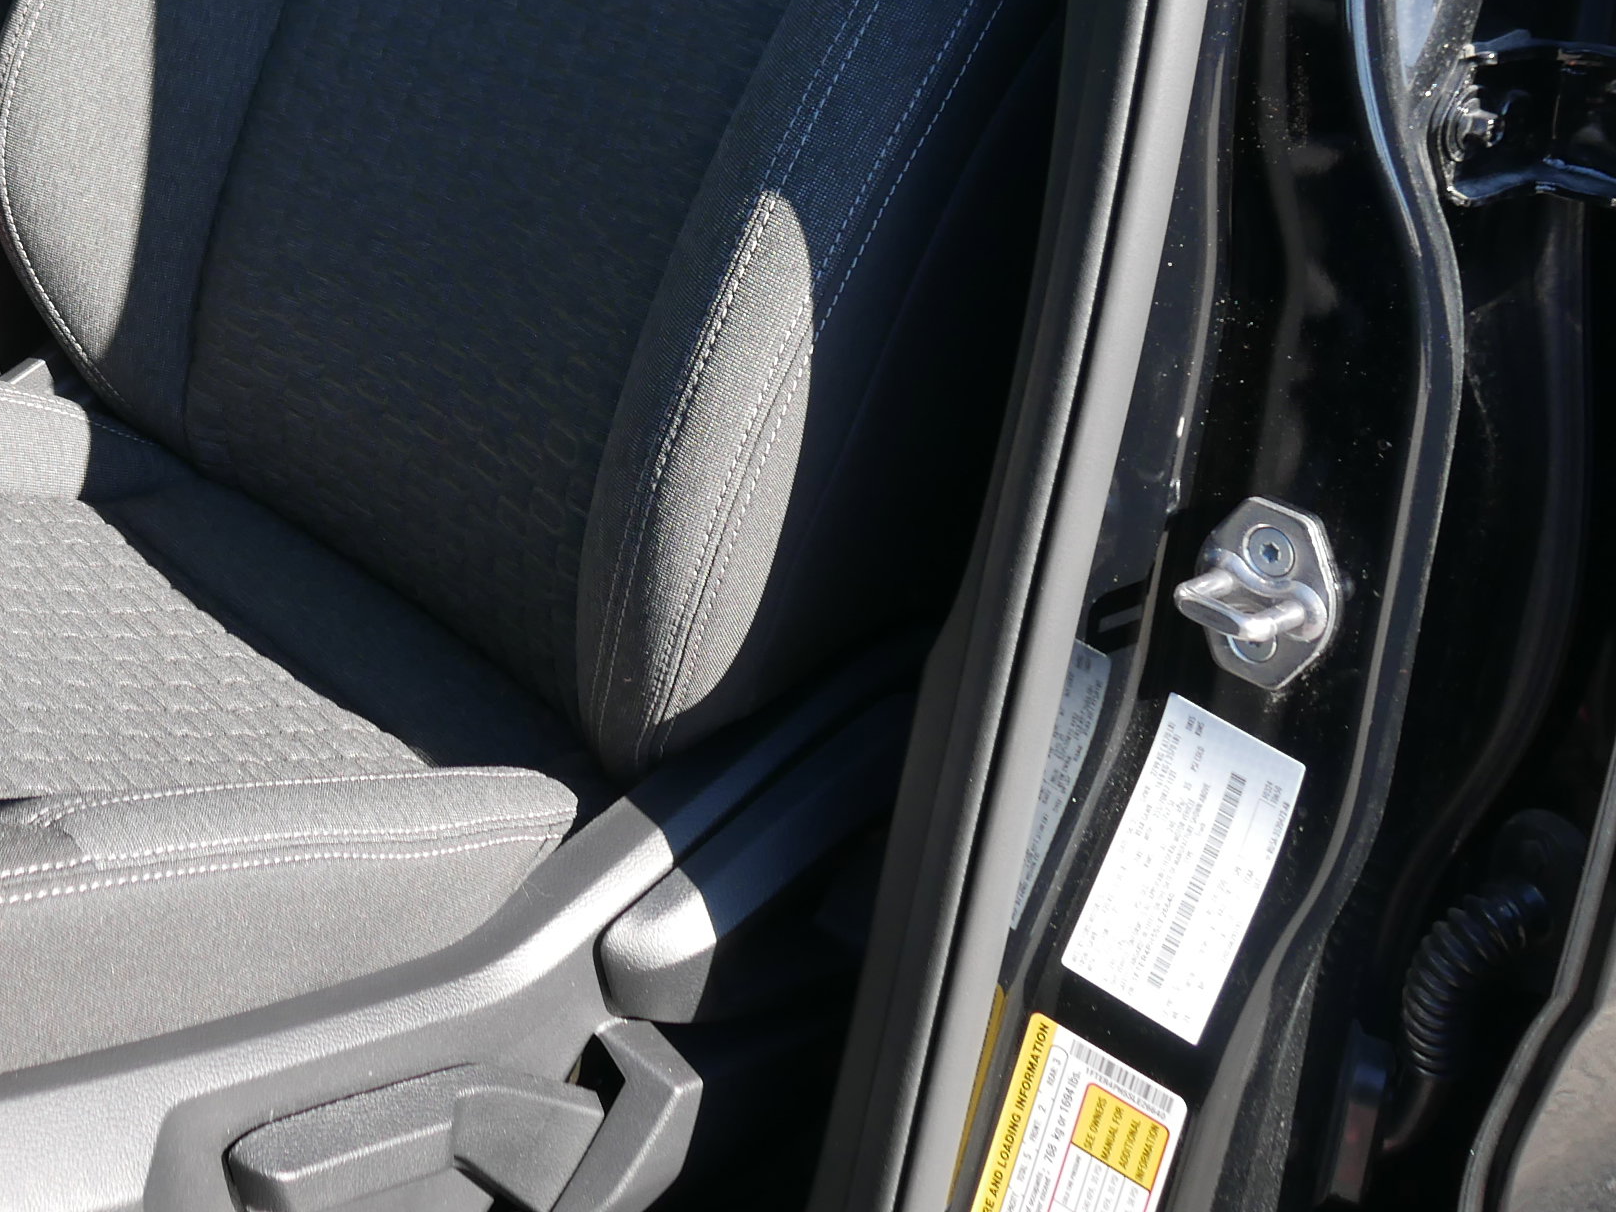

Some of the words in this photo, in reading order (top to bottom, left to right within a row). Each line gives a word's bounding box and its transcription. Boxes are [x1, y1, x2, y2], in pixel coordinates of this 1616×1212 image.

[986, 1167, 1003, 1198] AND
[995, 1110, 1022, 1168] LOADING
[1013, 1021, 1050, 1111] INFORMATION
[1058, 1085, 1075, 1114] 1694
[1087, 1094, 1108, 1135] OWNERS
[1051, 1125, 1065, 1142] kg
[1056, 1114, 1067, 1127] or
[1099, 1123, 1118, 1162] MANUAL
[1110, 1104, 1124, 1126] FOR
[1042, 1141, 1057, 1164] 768
[1082, 1131, 1096, 1151] SEE
[1116, 1115, 1141, 1170] ADDITIONAL
[1133, 1121, 1160, 1183] INFORMATION
